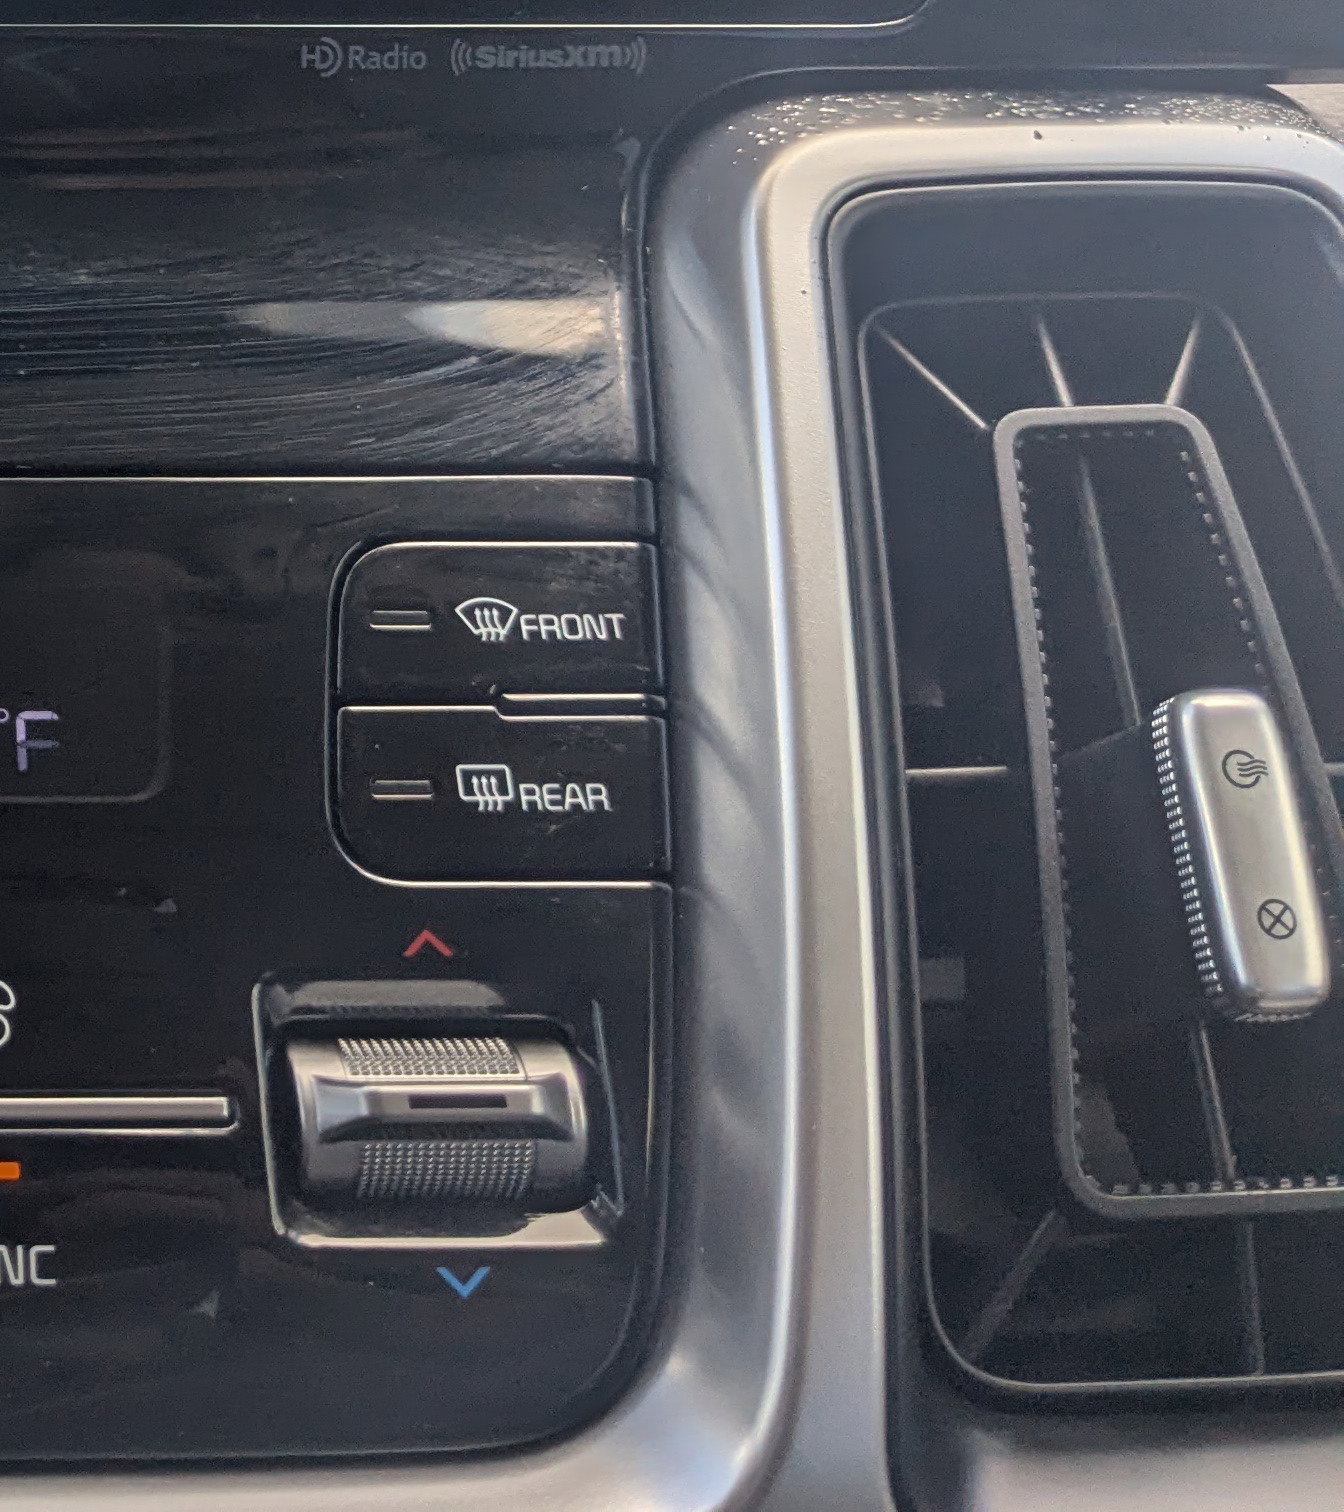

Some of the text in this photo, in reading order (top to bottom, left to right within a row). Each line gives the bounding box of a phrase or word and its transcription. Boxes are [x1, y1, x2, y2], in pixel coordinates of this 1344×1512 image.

[348, 42, 427, 70] Radio
[520, 612, 625, 641] FRONT
[519, 782, 612, 812] REAR
